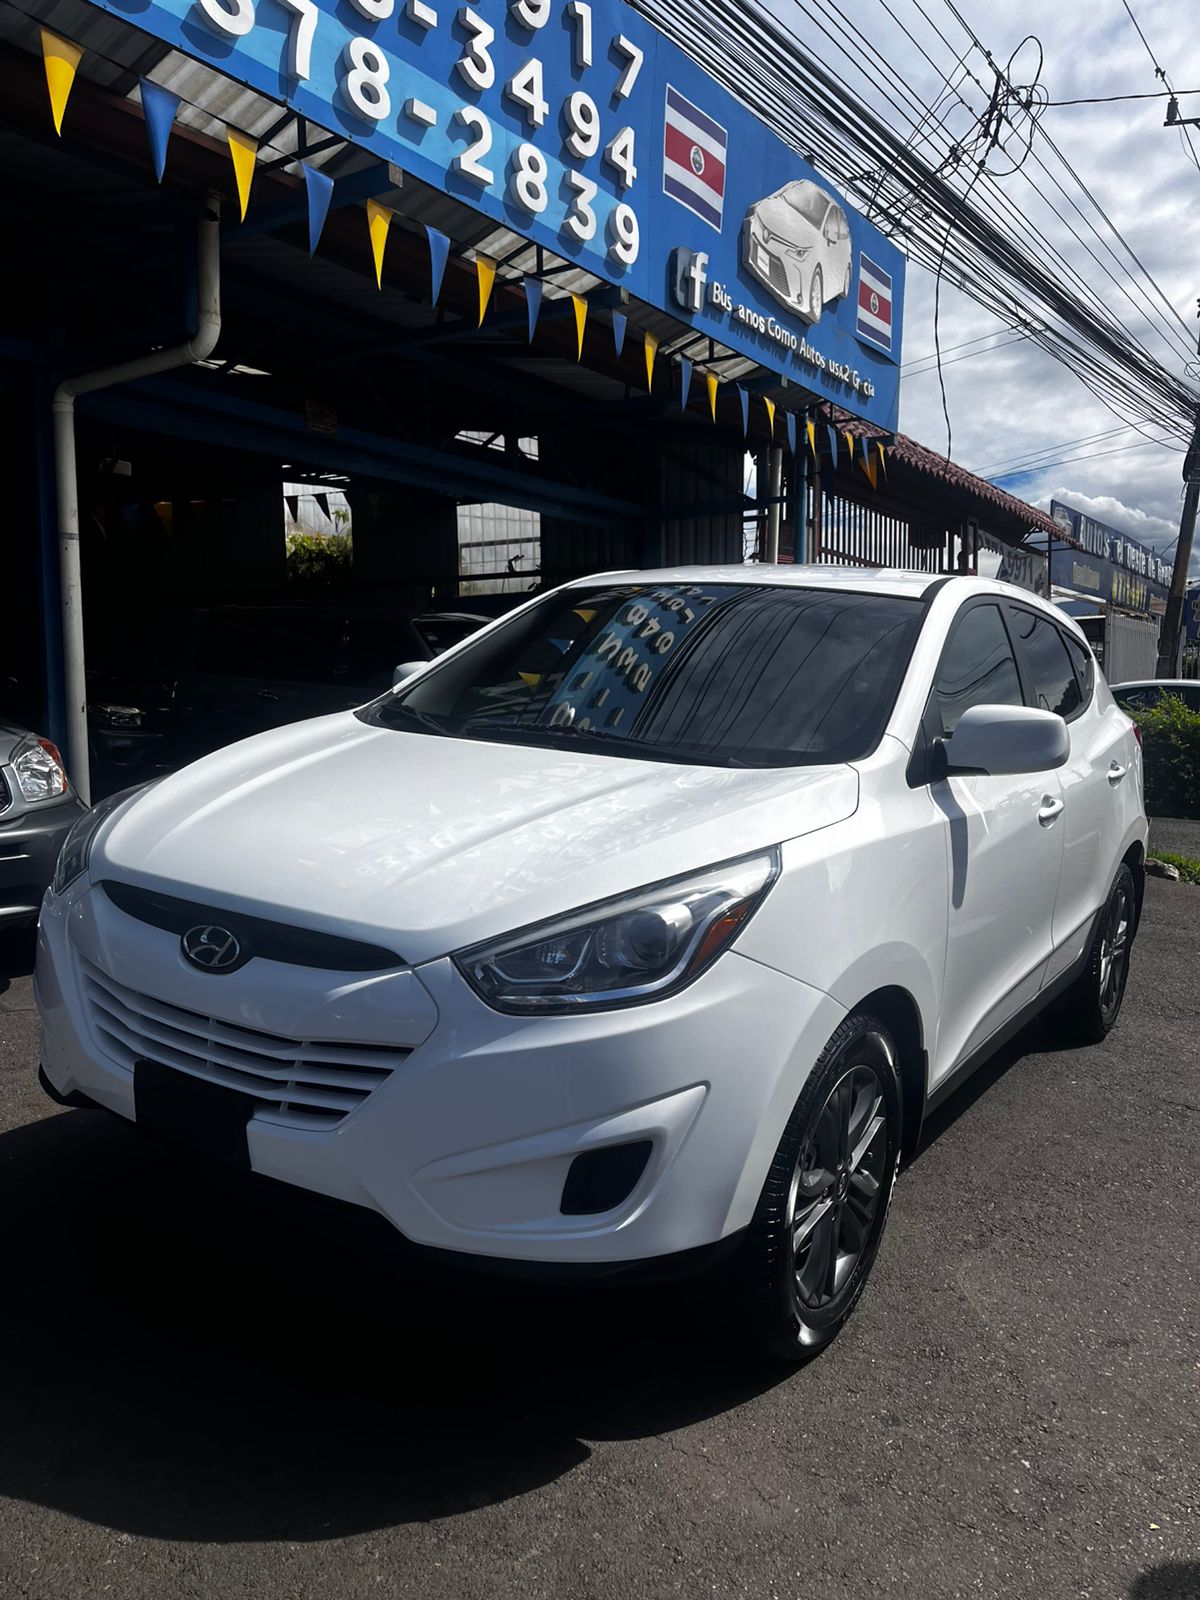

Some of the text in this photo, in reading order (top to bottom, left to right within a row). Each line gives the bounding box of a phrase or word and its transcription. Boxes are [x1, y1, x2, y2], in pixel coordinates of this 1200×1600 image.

[351, 0, 638, 190] -3494
[767, 316, 798, 350] Como
[800, 336, 826, 369] Autos
